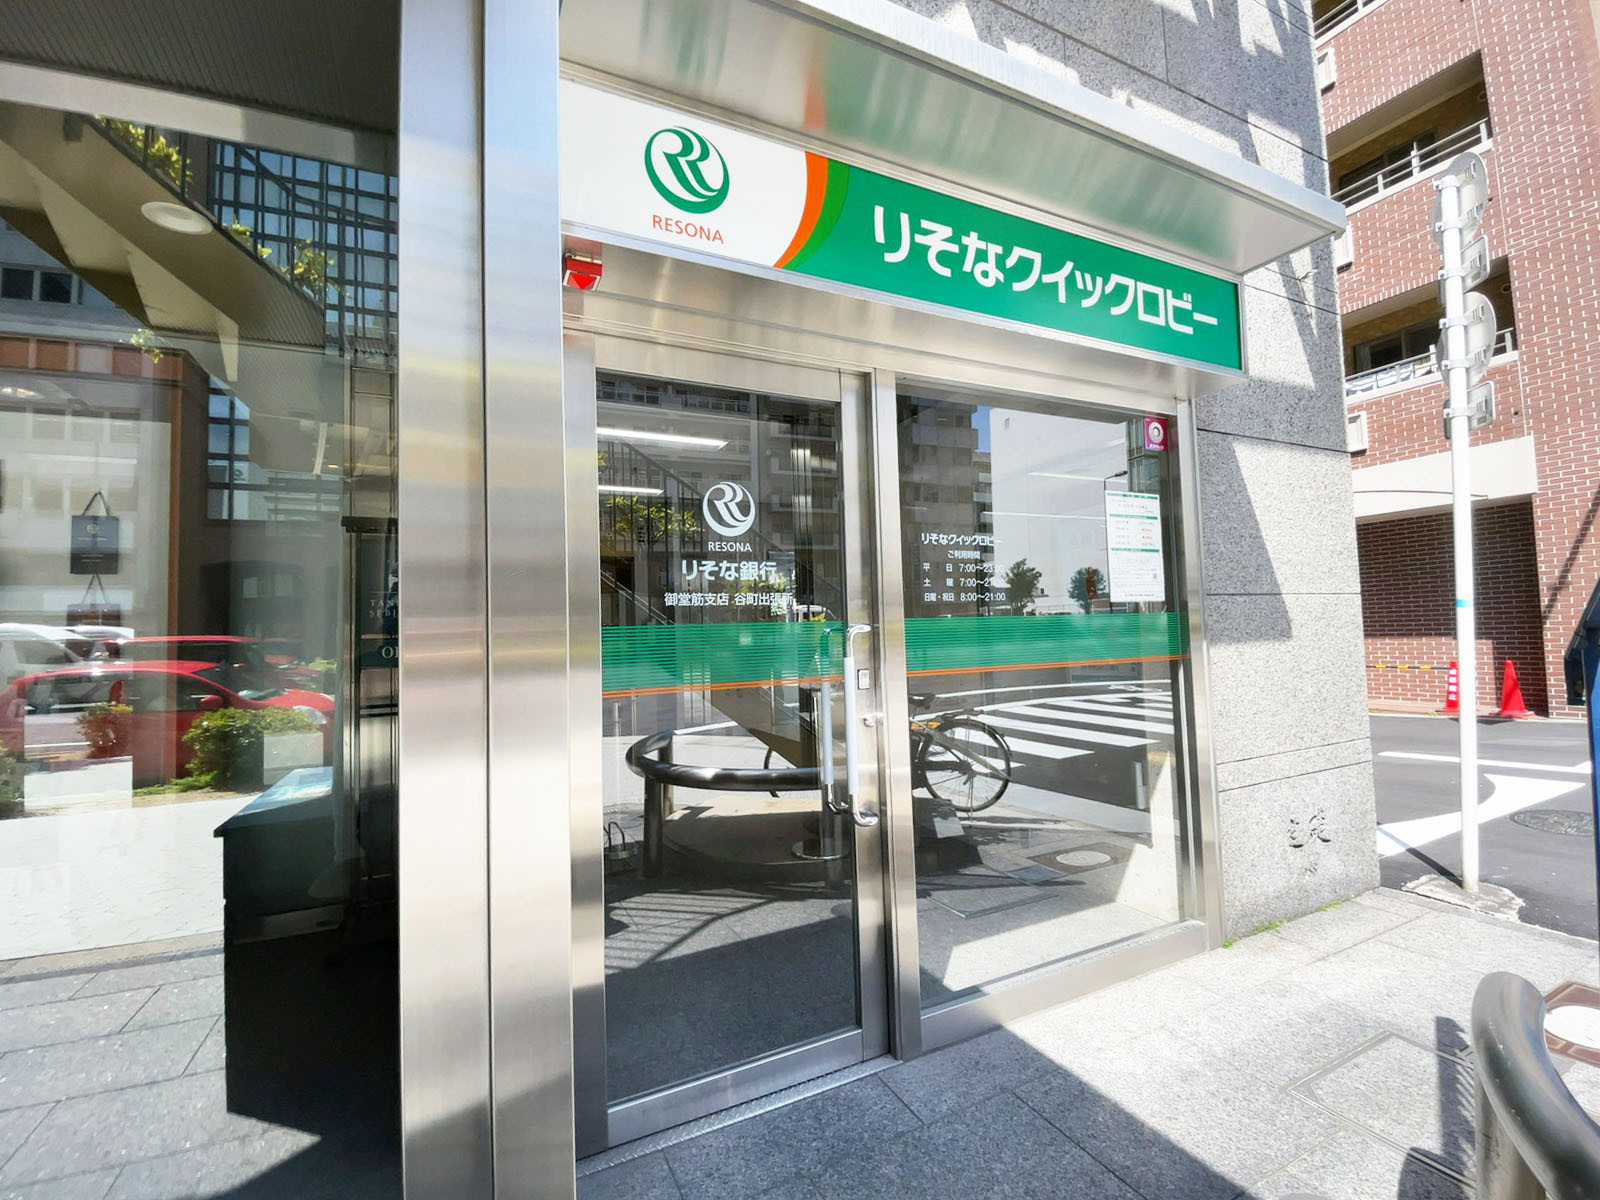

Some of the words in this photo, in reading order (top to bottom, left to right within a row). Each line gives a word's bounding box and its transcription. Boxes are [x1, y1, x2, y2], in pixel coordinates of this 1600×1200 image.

[652, 214, 725, 244] RESONA
[873, 204, 1218, 336] りそなクイックロビー
[708, 541, 752, 552] RESONA
[947, 550, 981, 559] ご利用時間
[682, 560, 777, 581] りそな銀行
[664, 592, 729, 607] 御堂筋支店
[734, 592, 793, 606] 谷町出張所
